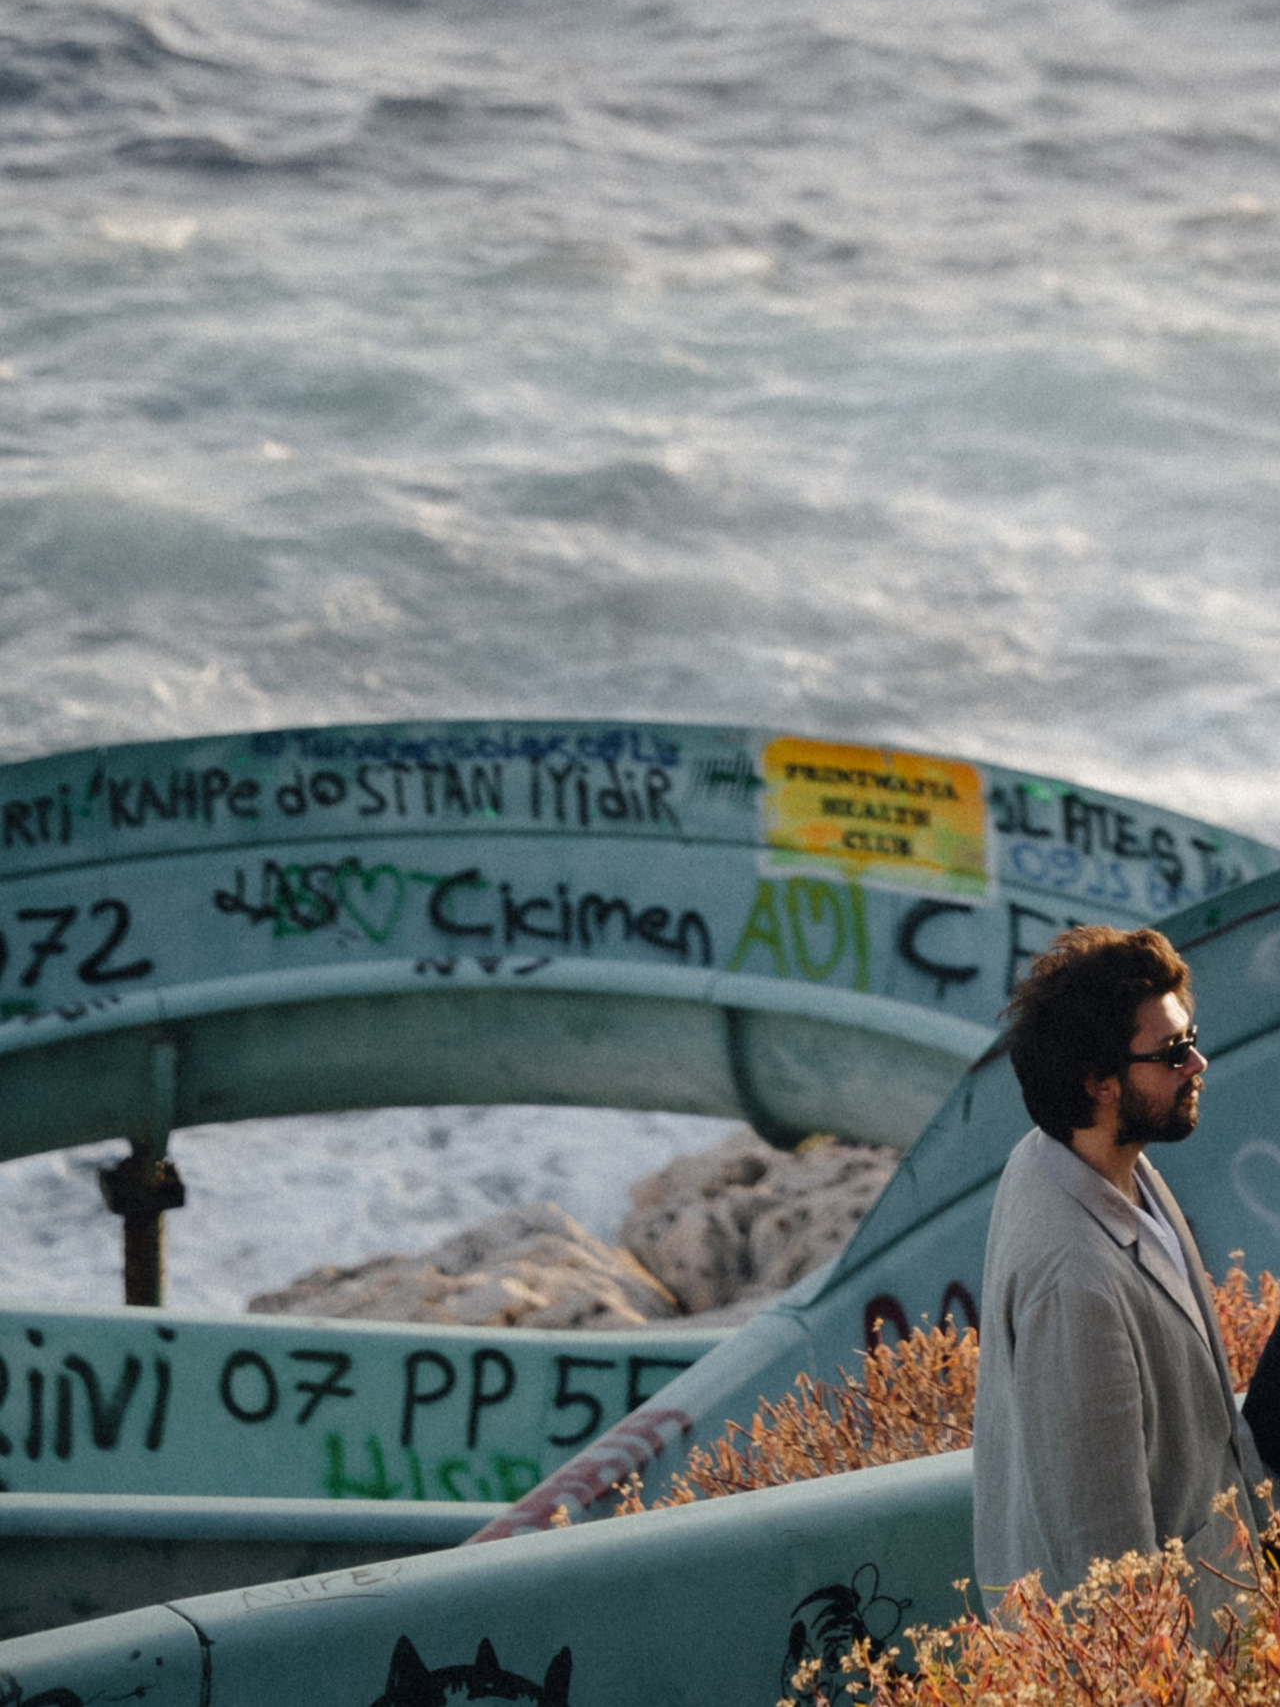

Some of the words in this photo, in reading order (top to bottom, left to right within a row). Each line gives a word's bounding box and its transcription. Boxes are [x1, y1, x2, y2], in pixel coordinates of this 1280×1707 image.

[0, 896, 154, 987] 72
[220, 1349, 355, 1426] 07
[403, 1347, 518, 1449] PP
